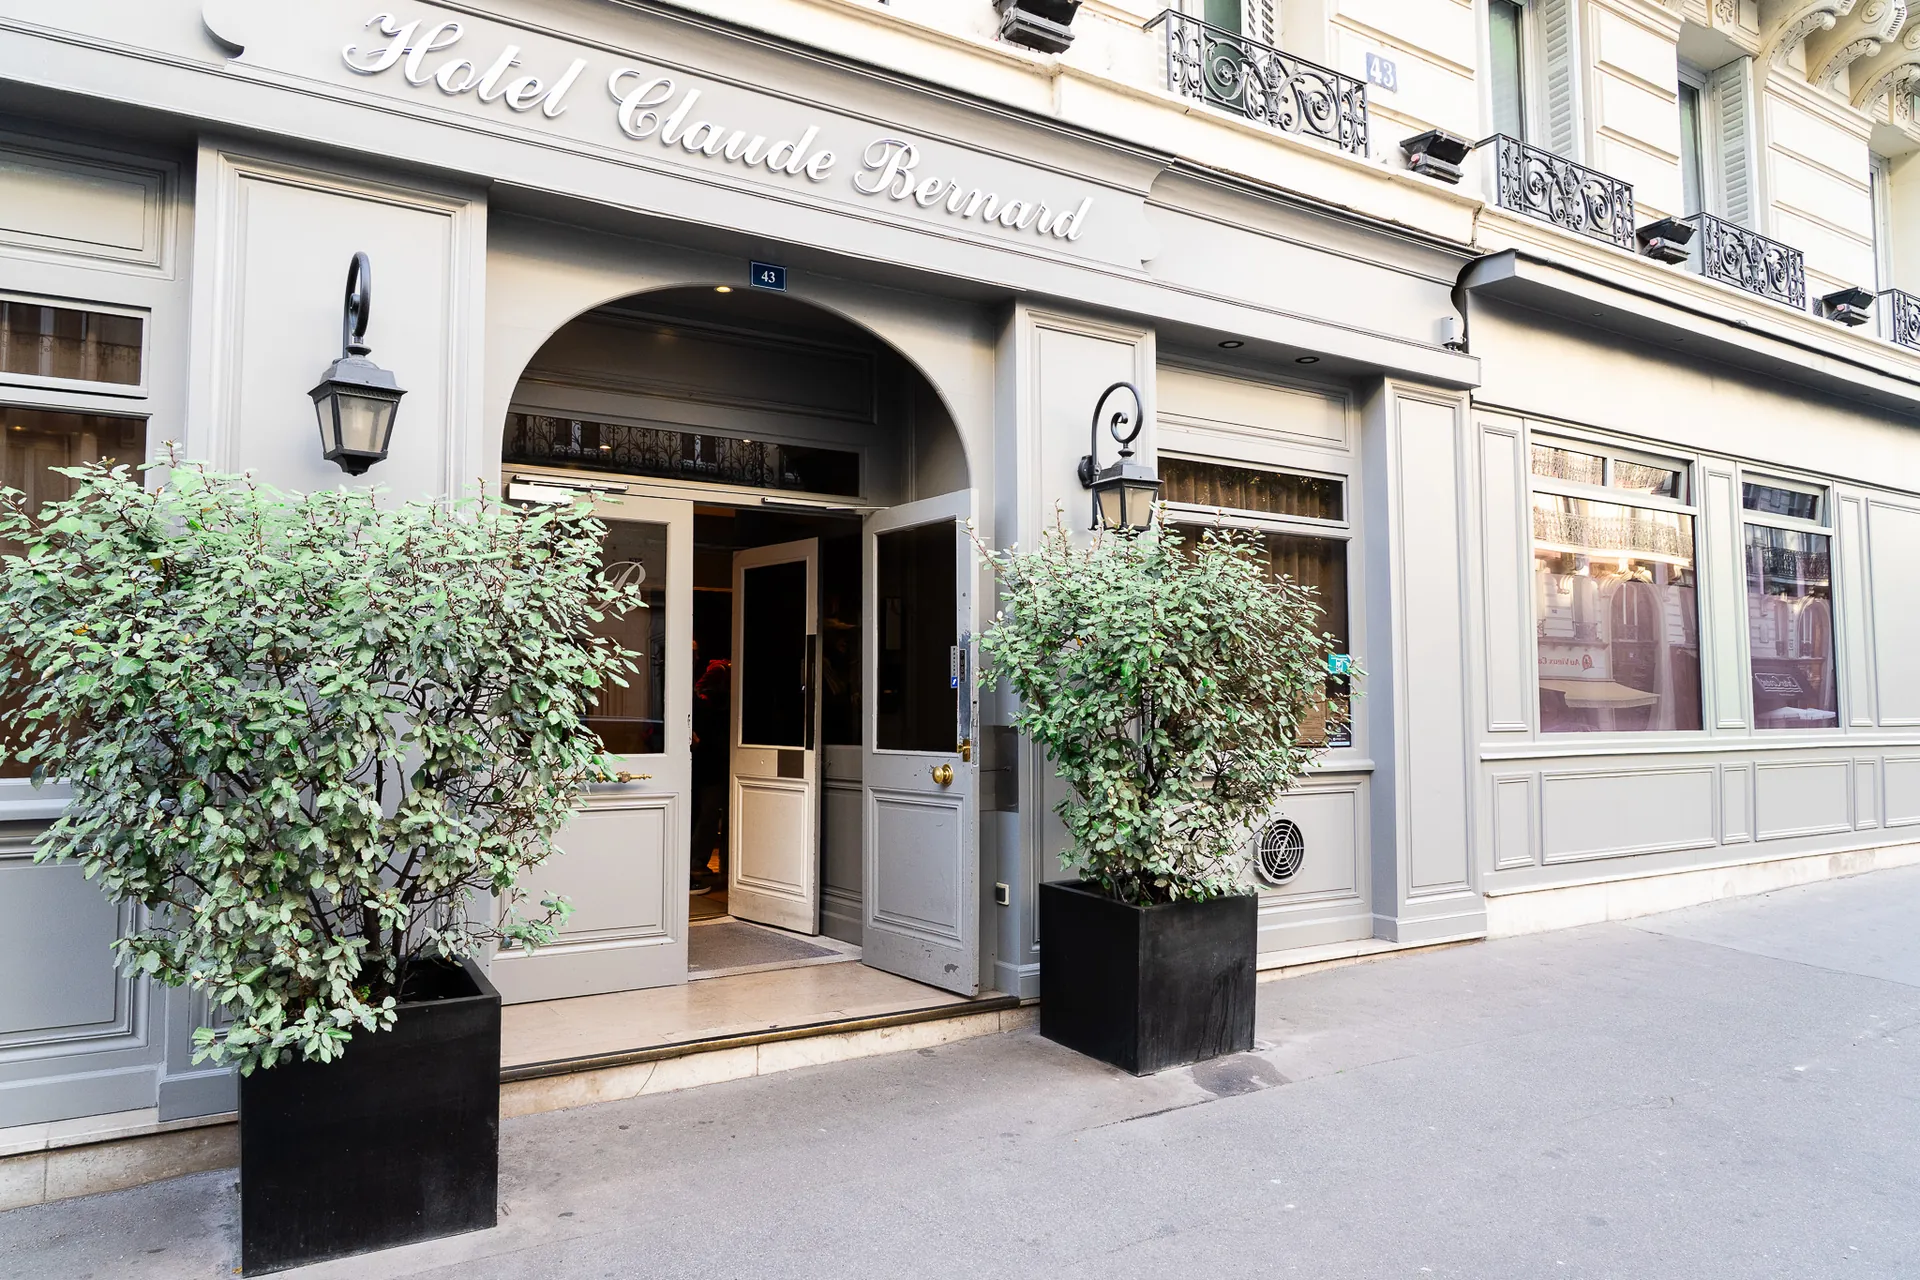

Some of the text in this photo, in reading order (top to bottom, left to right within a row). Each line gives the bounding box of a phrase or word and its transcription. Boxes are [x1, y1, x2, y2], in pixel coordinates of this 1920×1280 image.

[1370, 57, 1395, 88] 43
[342, 11, 1094, 242] Hotel Claude Bernard
[761, 270, 776, 284] 43
